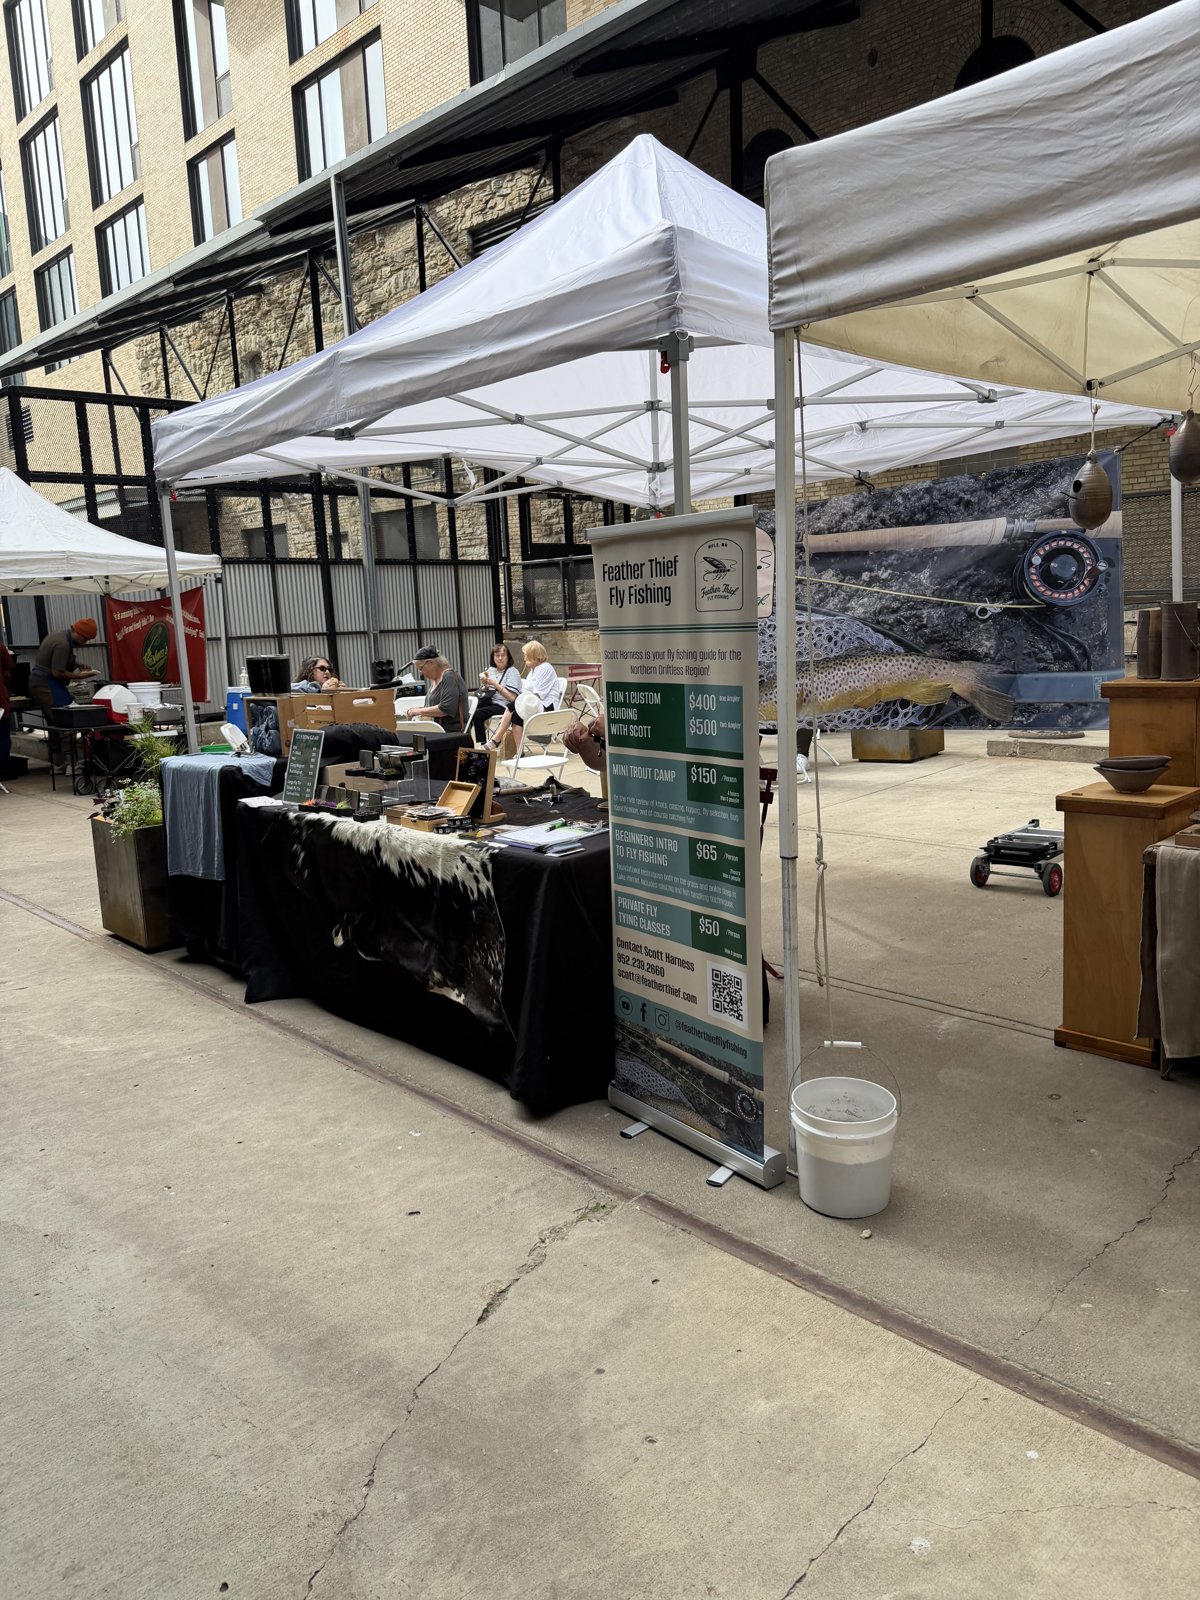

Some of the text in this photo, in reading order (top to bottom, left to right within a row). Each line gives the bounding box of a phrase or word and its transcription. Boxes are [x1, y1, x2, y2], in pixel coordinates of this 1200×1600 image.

[602, 555, 678, 582] Feather Thief
[609, 583, 671, 608] Fly Fishing
[604, 649, 742, 662] Scott Harness is your fly fishing guide for the
[630, 665, 658, 676] Northern
[658, 665, 684, 676] Driftless
[609, 691, 661, 705] 1 ON 1 CUSTOM
[689, 692, 716, 712] $400
[610, 707, 638, 720] GUIDING
[610, 724, 652, 738] WITH SCOTT
[690, 716, 718, 736] $500
[612, 764, 676, 782] MINI TROUT CAMP
[691, 765, 716, 784] $150
[616, 830, 678, 852] BEGINNERS INTRO
[696, 841, 717, 861] $65
[616, 845, 668, 866] TO FLY FISHING
[618, 896, 658, 918] PRIVATE FLY
[618, 912, 671, 937] TYING CLASSES
[699, 916, 720, 936] $50
[616, 937, 695, 972] Contact Scott Harness
[616, 952, 664, 978] 952.239.2660
[618, 968, 698, 1005] scott@featherthief.com
[674, 1019, 748, 1060] @featherthiefflyfishing
